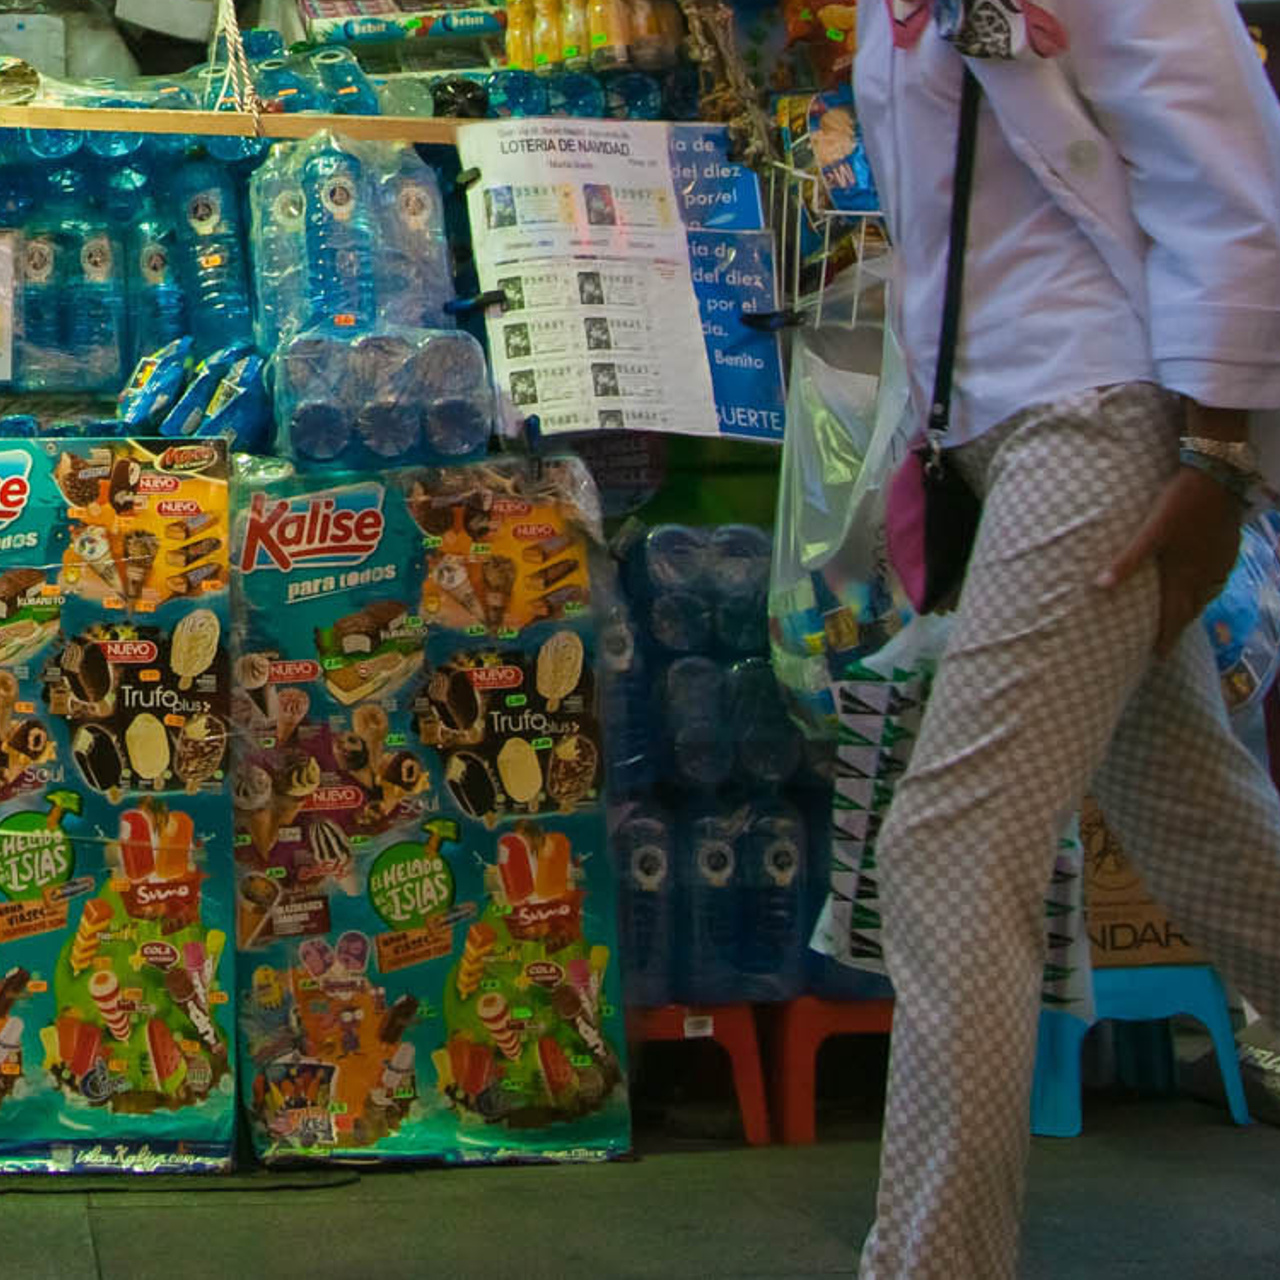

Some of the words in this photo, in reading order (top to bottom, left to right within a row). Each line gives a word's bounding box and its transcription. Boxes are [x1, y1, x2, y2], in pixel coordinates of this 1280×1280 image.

[500, 138, 557, 155] LOTERIA
[558, 138, 575, 153] DE
[703, 163, 742, 179] diez
[725, 270, 763, 287] diez
[714, 348, 764, 369] Benito
[139, 479, 176, 489] NUEVO
[241, 492, 383, 572] Kalise
[286, 579, 335, 599] para
[107, 643, 149, 657] NUEVO
[269, 664, 312, 677] NUEVO
[473, 669, 515, 683] NUEVO
[121, 685, 178, 709] Trufo
[490, 711, 546, 735] Trufo
[312, 790, 356, 804] NUEVO
[4, 844, 69, 892] ISLAS
[388, 873, 449, 922] ISLAS
